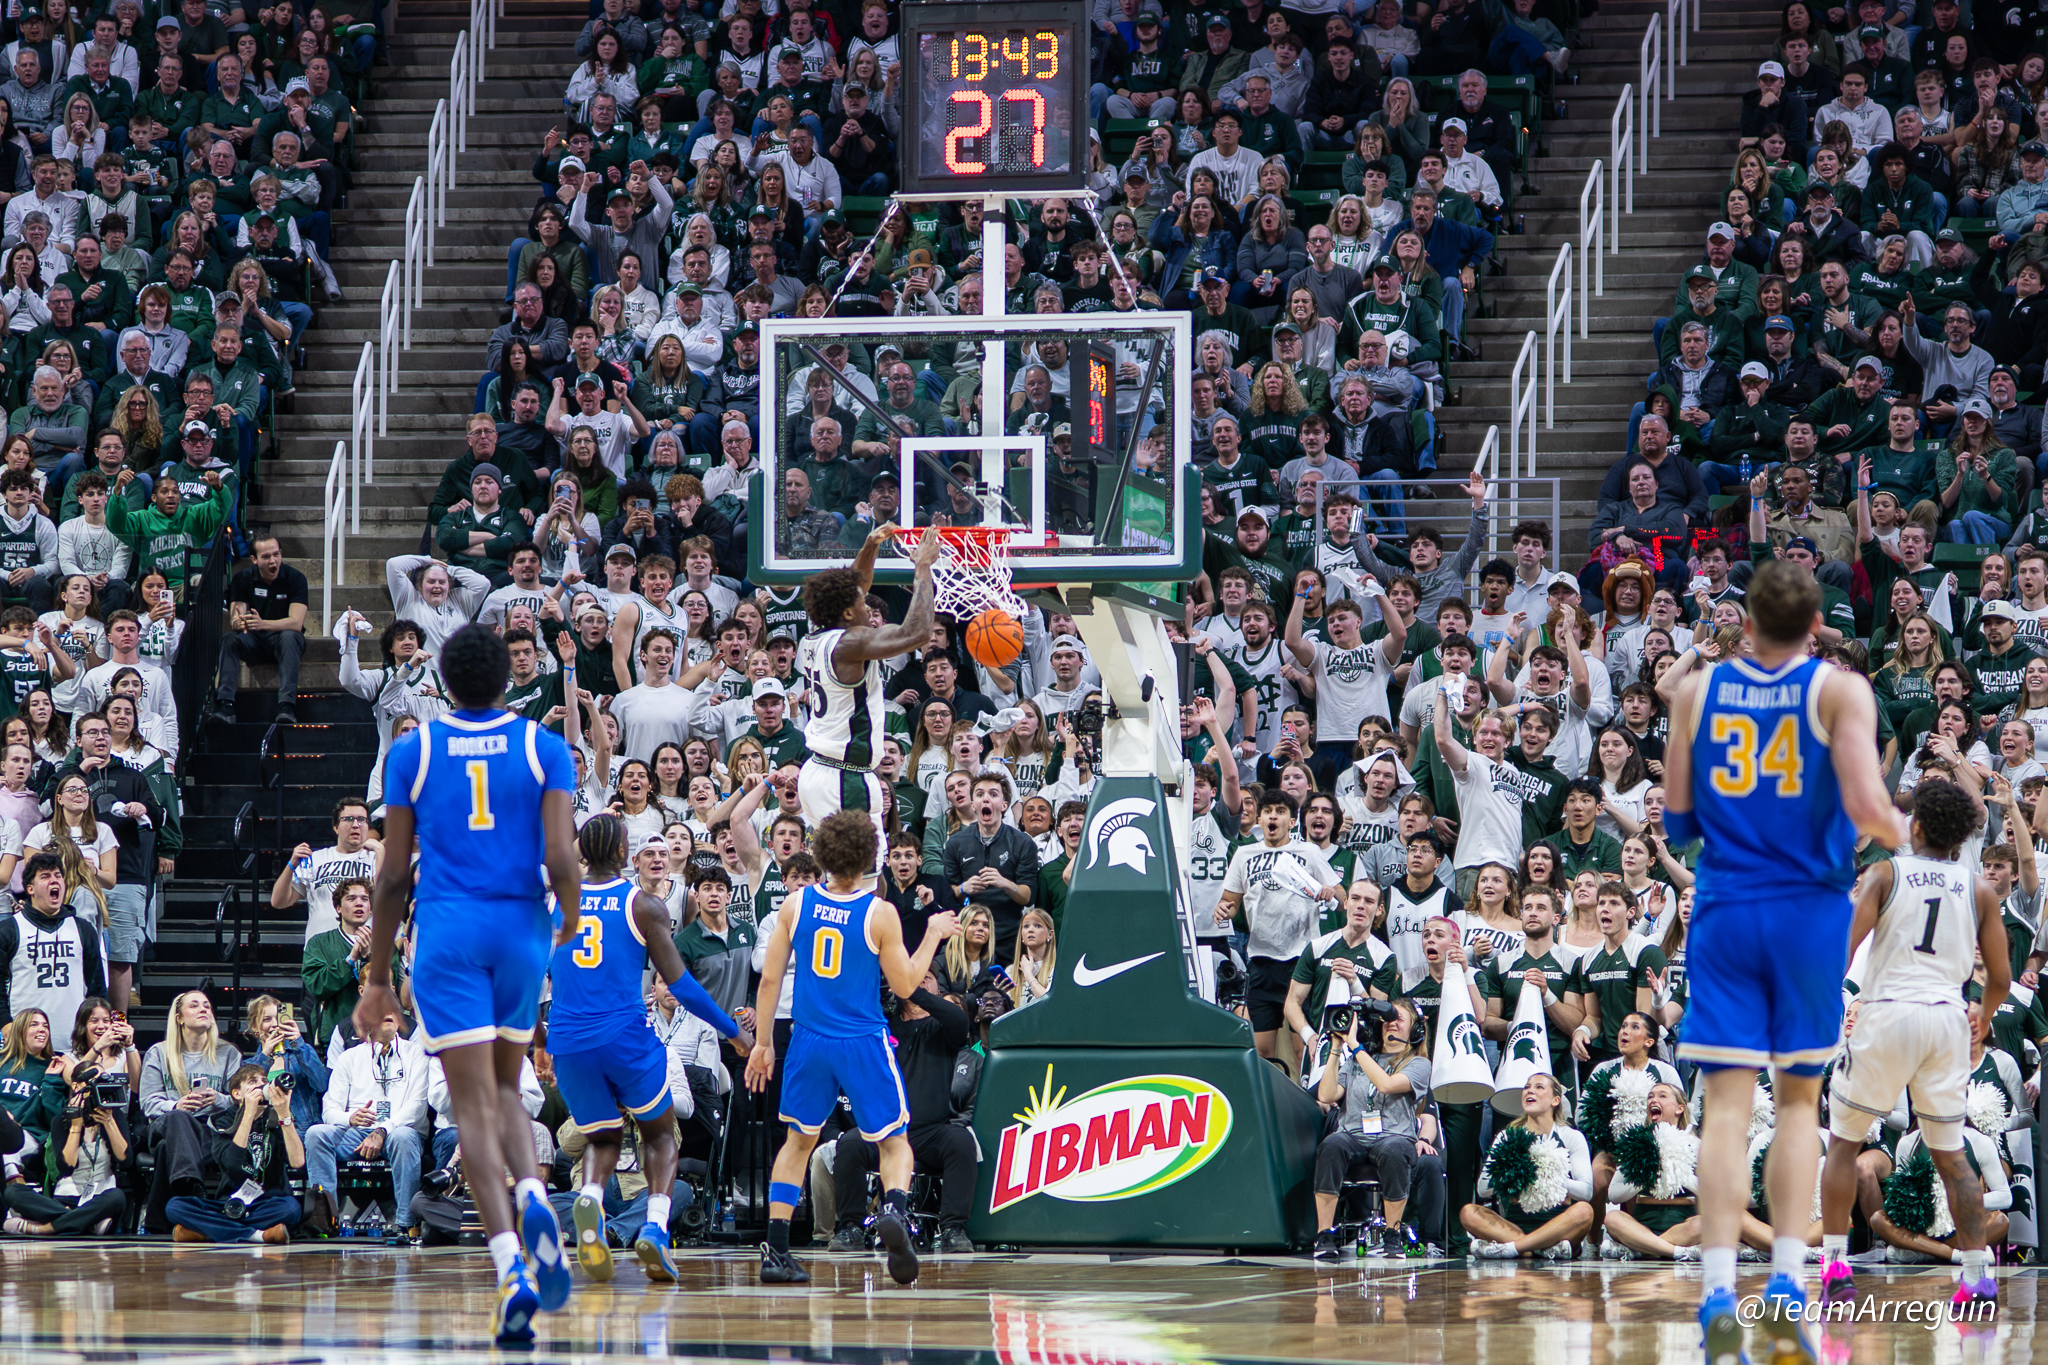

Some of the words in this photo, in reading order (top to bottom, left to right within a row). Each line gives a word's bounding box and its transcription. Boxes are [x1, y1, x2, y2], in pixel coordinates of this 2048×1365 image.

[950, 31, 1060, 82] 13:43
[1131, 62, 1162, 77] MSU
[944, 88, 1045, 175] 27
[1070, 298, 1103, 313] MICHIG
[0, 541, 37, 552] PARTANS
[155, 551, 186, 571] STAT
[766, 610, 807, 624] SPARTANS
[1987, 602, 1997, 612] S
[4, 660, 47, 672] Stat
[1976, 667, 2026, 687] MICHIGAN
[446, 734, 509, 757] BOOKER
[1710, 712, 1804, 798] 34
[465, 760, 496, 831] 1
[1191, 856, 1229, 881] 33
[1905, 871, 1946, 889] FEARS
[602, 896, 621, 912] JR.
[812, 903, 852, 926] PERRY
[1914, 897, 1942, 956] 1
[27, 940, 76, 959] STATE
[573, 915, 603, 968] 3
[36, 962, 70, 989] 23
[991, 1092, 1213, 1211] LIBMAN
